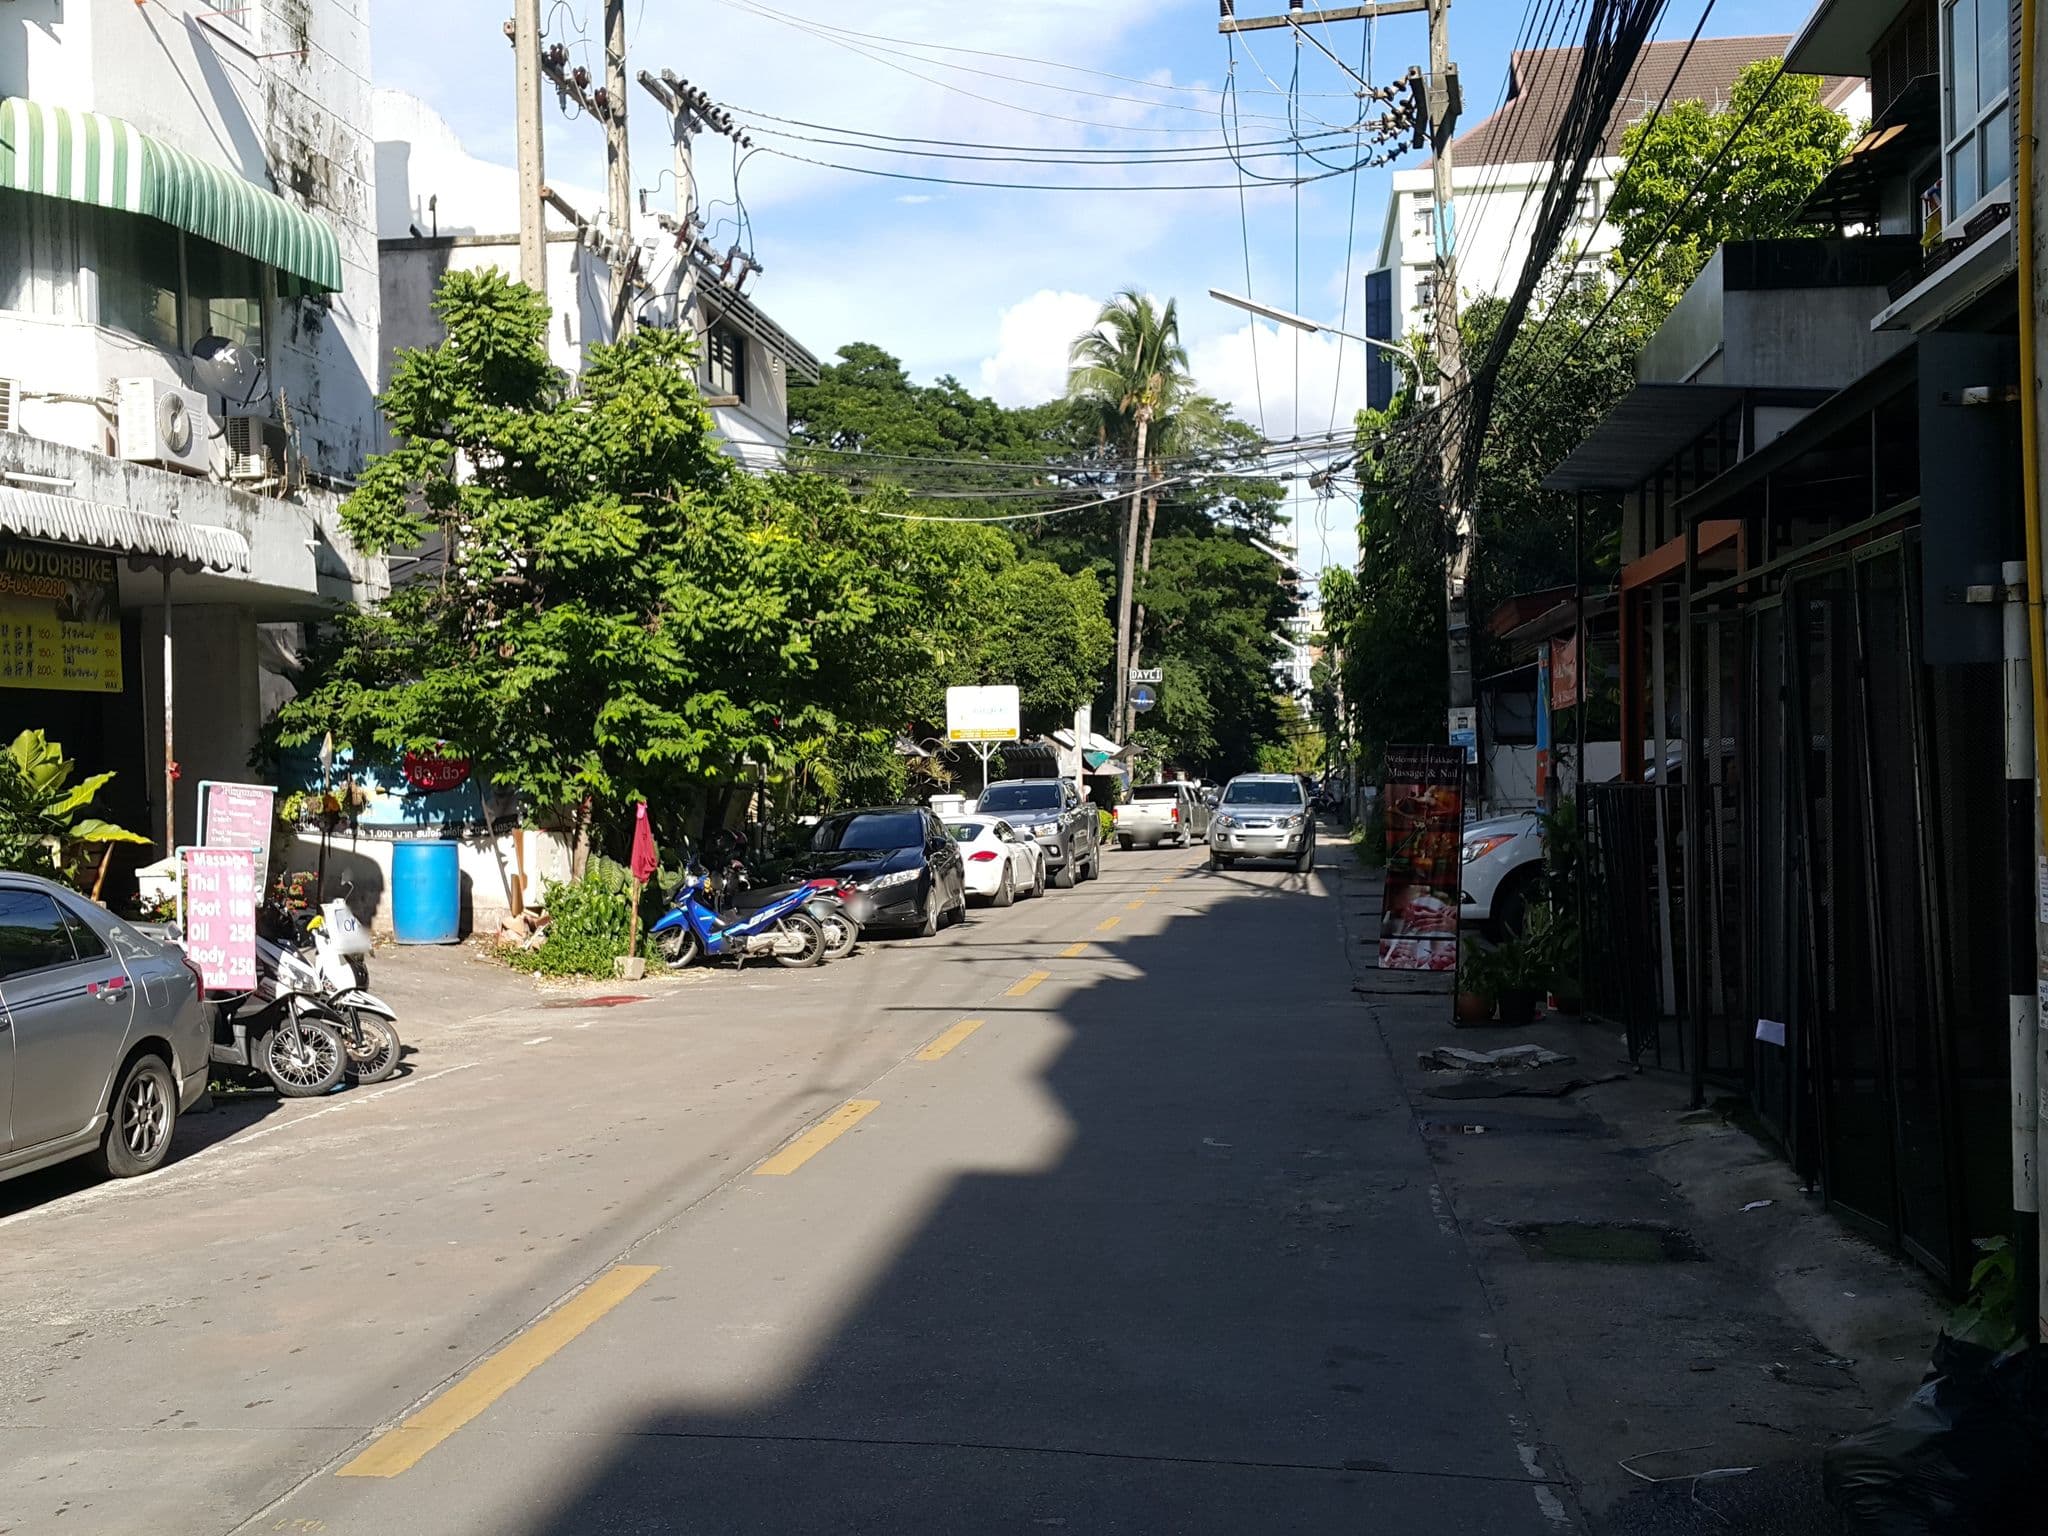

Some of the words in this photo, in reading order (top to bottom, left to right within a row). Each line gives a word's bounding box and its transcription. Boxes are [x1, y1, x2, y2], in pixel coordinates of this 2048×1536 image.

[5, 547, 112, 583] MOTORBIKE
[1388, 767, 1425, 780] Massage
[1427, 768, 1437, 778] &
[1440, 767, 1458, 778] Nail
[193, 852, 249, 870] Massage
[190, 873, 219, 893] Thai
[190, 898, 221, 917] Foot
[190, 922, 210, 941] Oil
[229, 923, 254, 942] 250
[190, 946, 225, 967] Body
[229, 957, 254, 976] 250
